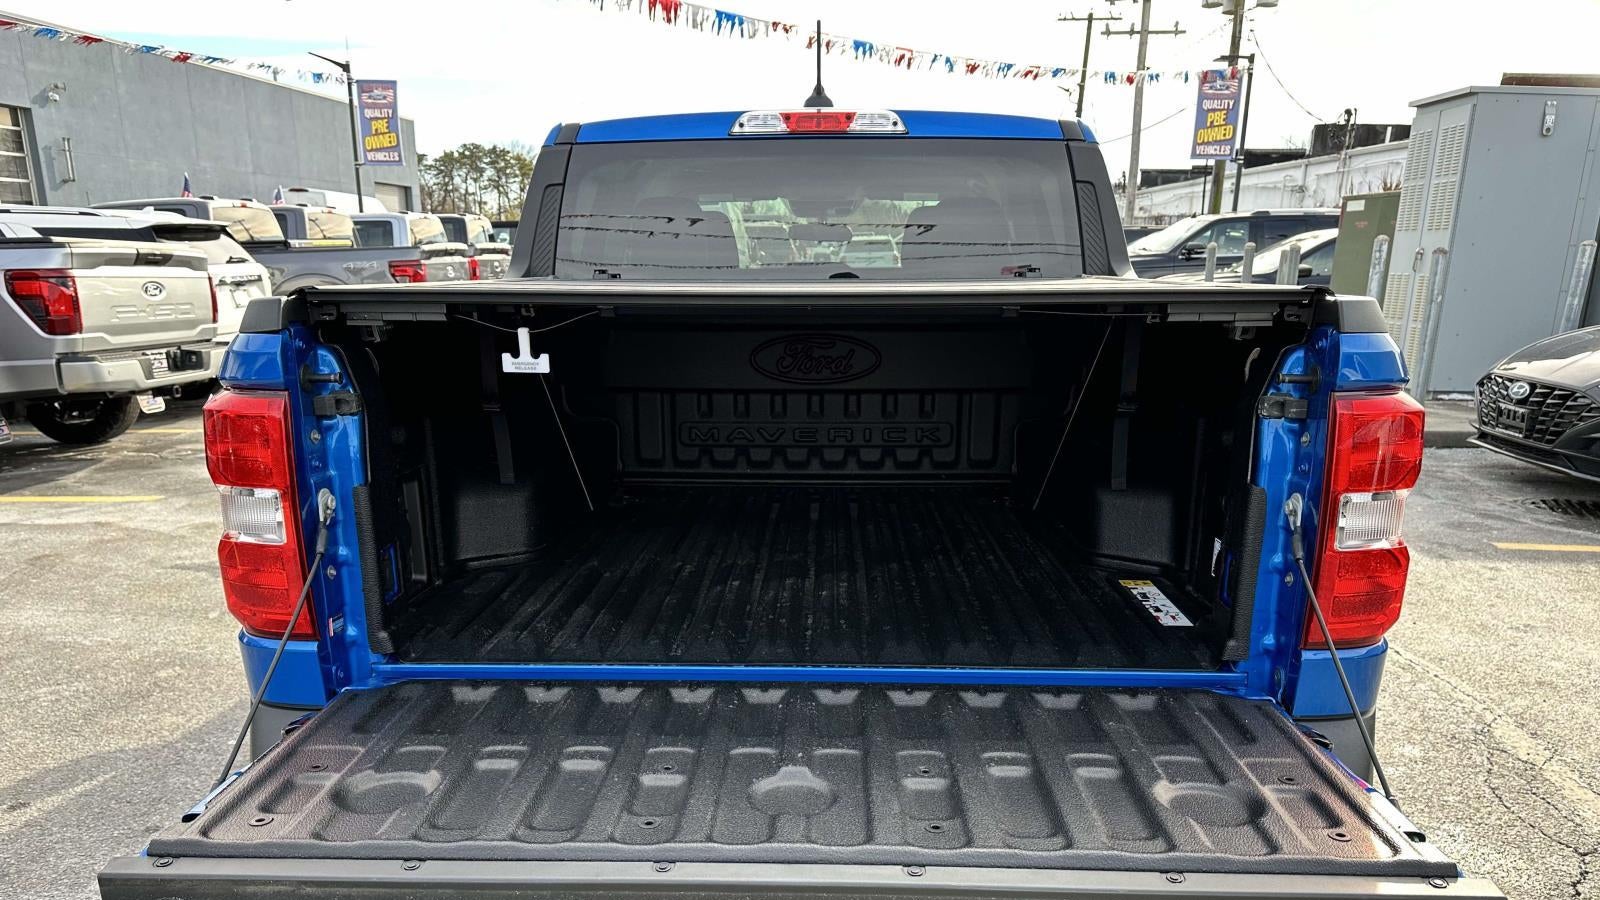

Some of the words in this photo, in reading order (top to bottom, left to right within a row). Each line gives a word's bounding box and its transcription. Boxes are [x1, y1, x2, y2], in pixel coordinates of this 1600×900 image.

[1202, 99, 1235, 110] QUALITY
[364, 108, 393, 119] QUALITY
[371, 119, 389, 134] PRE
[365, 133, 397, 150] OWNED
[1197, 125, 1233, 144] OWNED
[366, 151, 400, 161] VEHICLES
[1195, 145, 1231, 155] VEHICLES
[775, 338, 855, 374] Ford
[688, 426, 942, 444] MAVERICK
